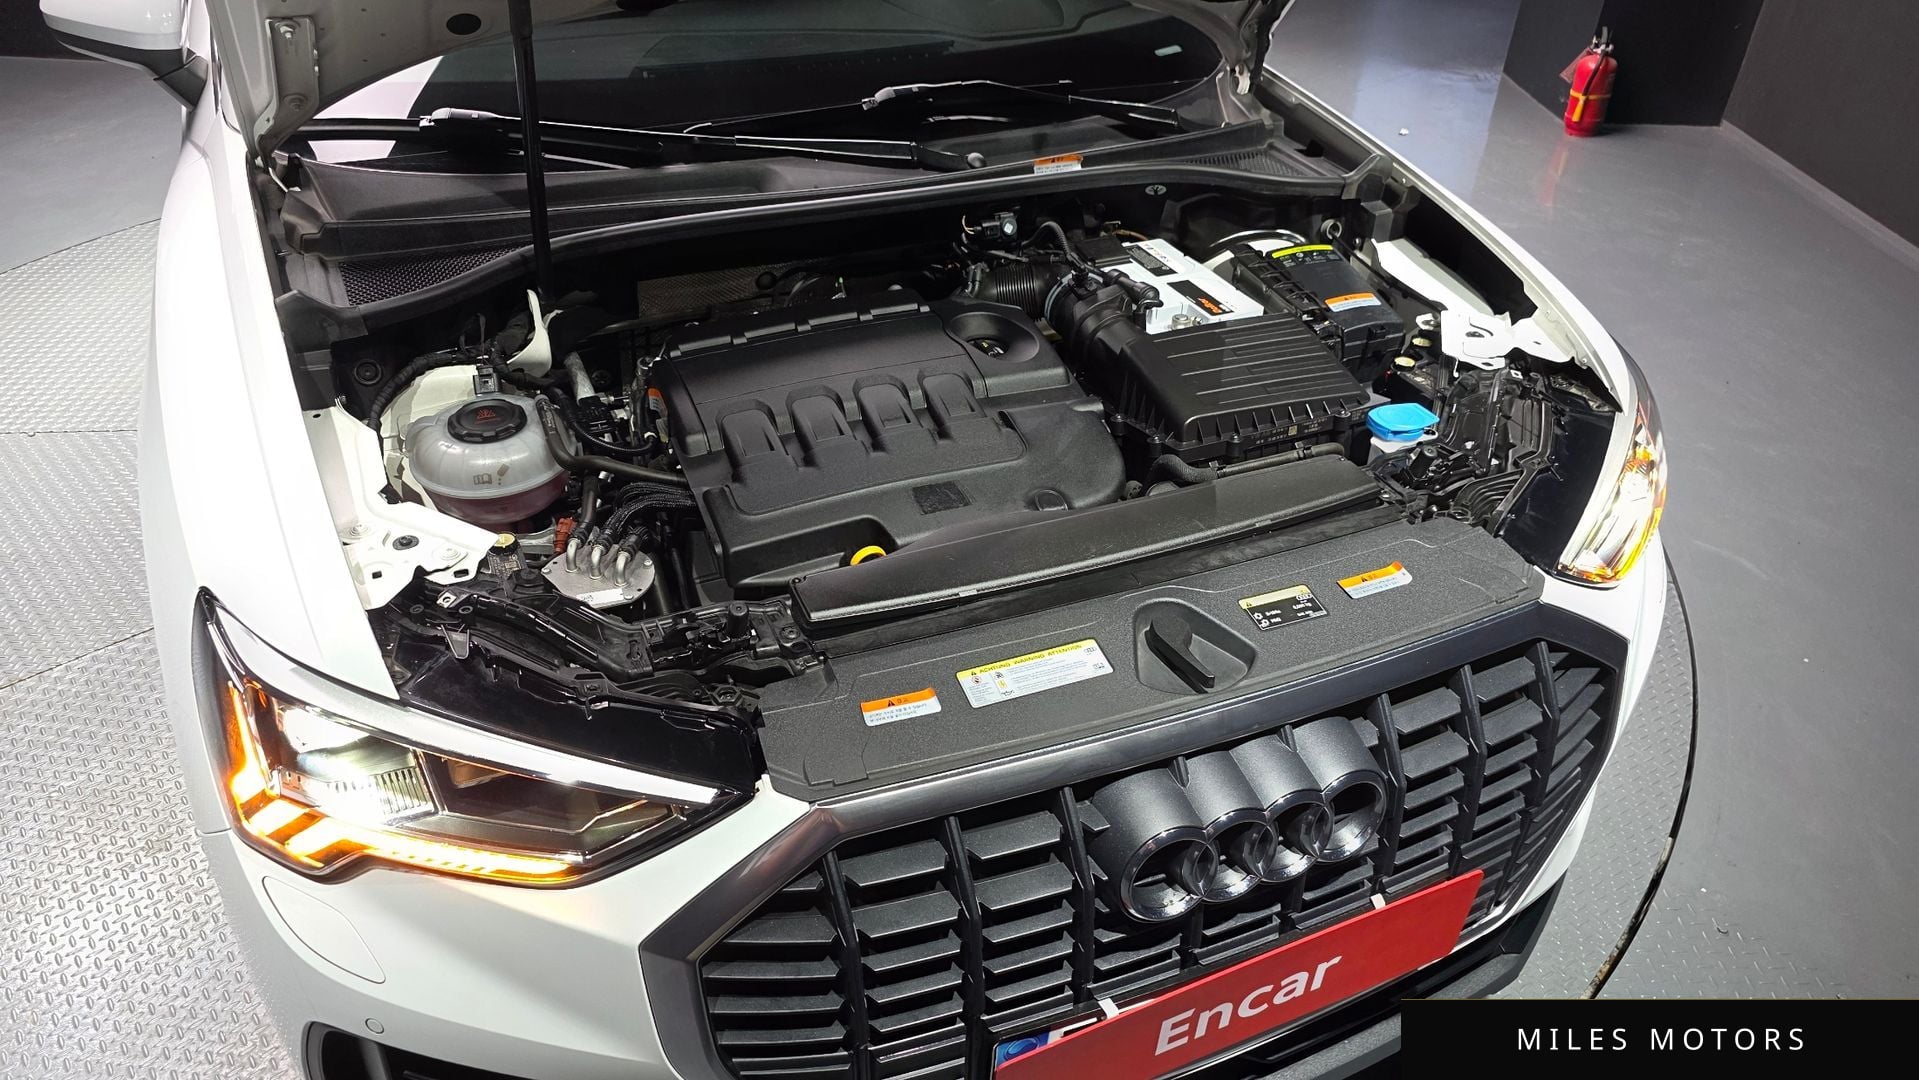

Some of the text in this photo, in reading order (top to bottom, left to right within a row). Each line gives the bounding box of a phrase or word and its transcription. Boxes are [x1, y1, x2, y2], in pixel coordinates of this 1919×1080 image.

[979, 644, 1082, 673] ACHTUNG WARNING ATTENTION
[1154, 955, 1343, 1056] Encar
